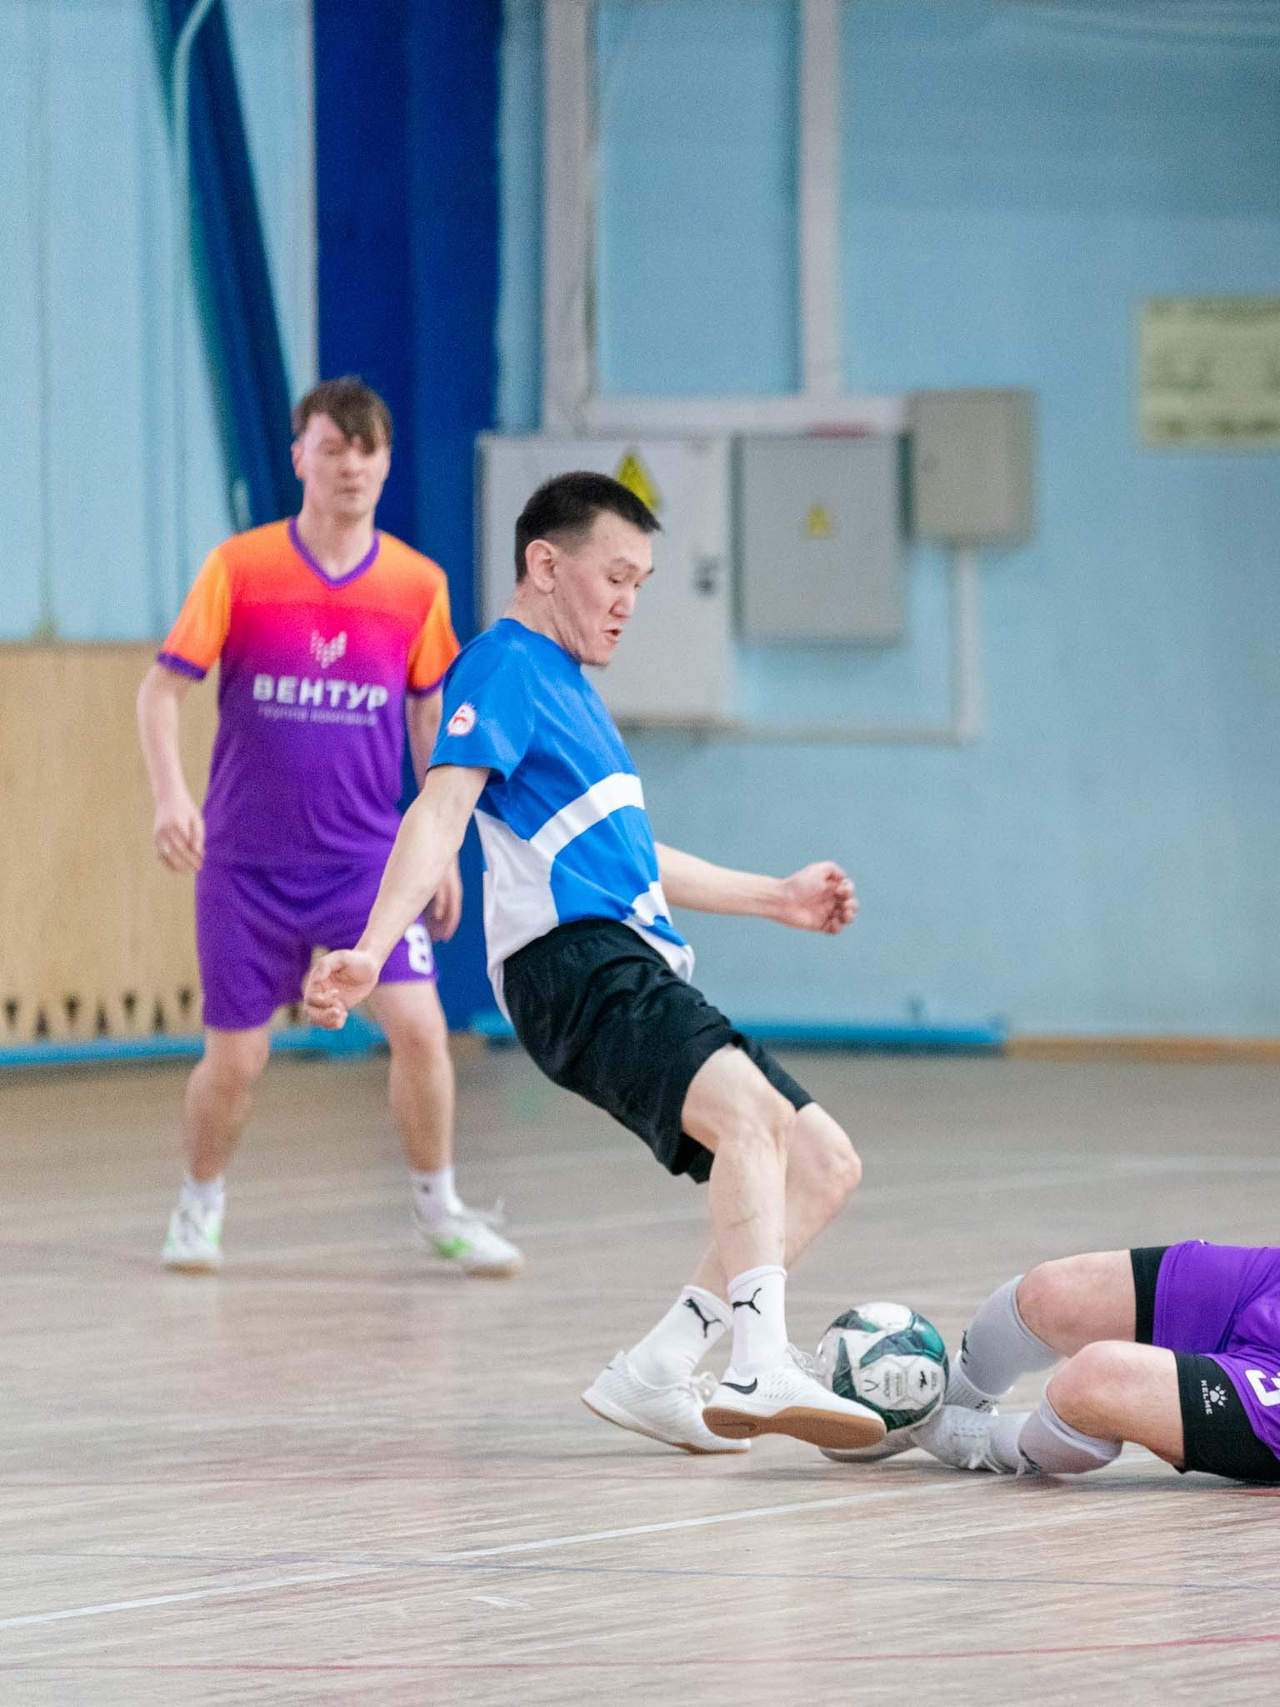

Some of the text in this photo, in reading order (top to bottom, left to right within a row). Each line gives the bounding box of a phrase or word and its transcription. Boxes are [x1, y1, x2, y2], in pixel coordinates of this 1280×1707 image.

[253, 673, 388, 711] ВЕНТУР
[404, 923, 434, 975] 8
[1201, 1379, 1213, 1416] KELME
